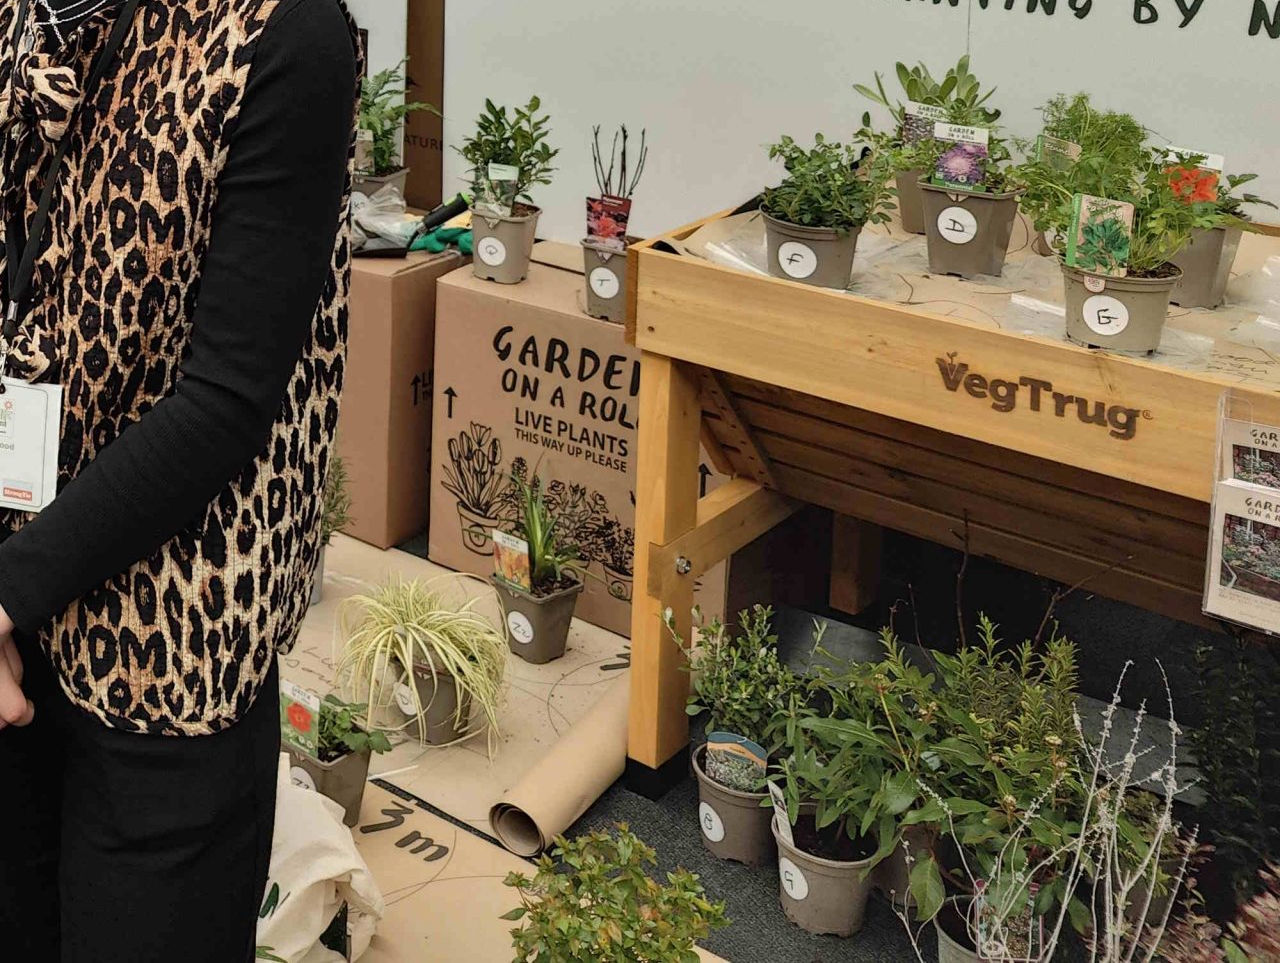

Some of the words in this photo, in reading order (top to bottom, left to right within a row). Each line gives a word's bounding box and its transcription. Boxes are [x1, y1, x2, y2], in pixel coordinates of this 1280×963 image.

[948, 126, 976, 136] GARDEN
[502, 368, 539, 401] ON
[550, 386, 565, 408] A
[579, 391, 638, 430] ROL
[515, 407, 552, 434] LIVE
[557, 420, 629, 457] PLANTS
[515, 428, 539, 445] THIS
[541, 436, 565, 453] WAY
[567, 444, 583, 457] UP
[585, 449, 627, 473] PLEASE
[1248, 508, 1262, 517] ON
